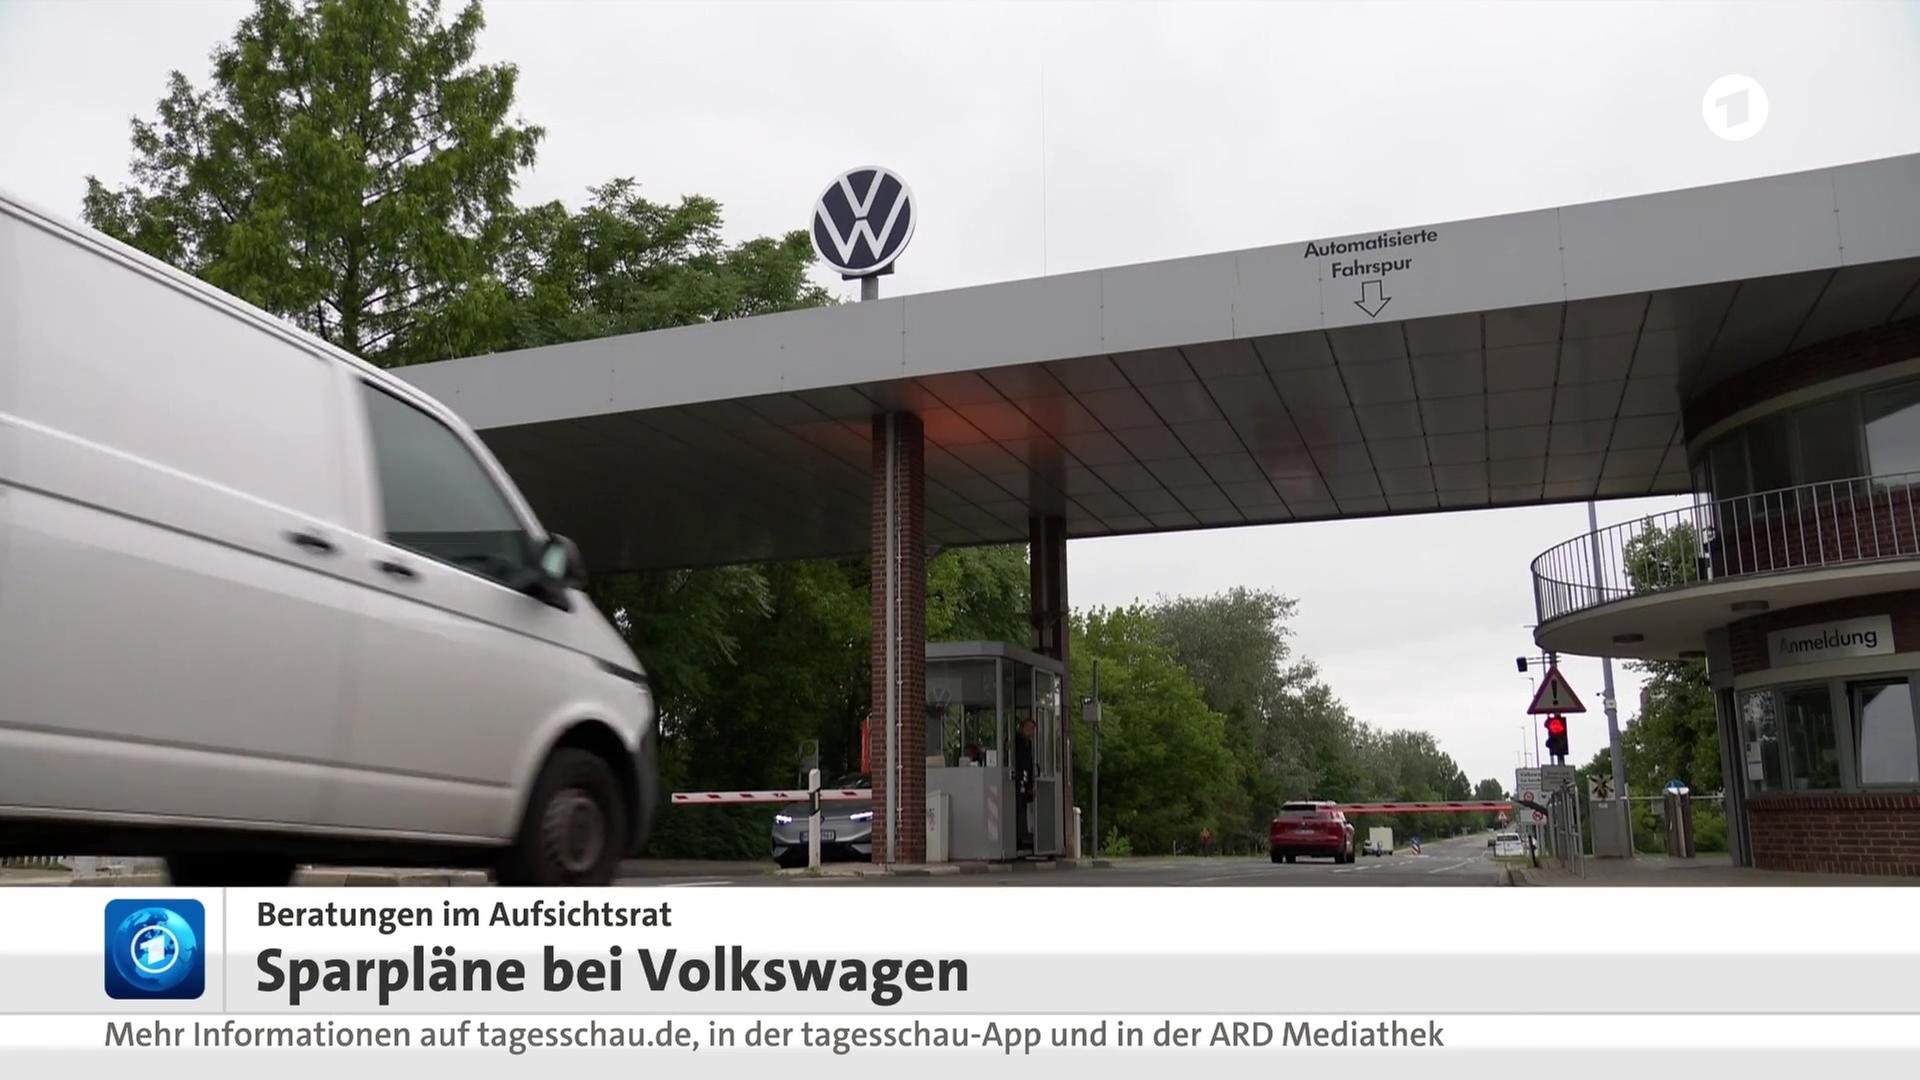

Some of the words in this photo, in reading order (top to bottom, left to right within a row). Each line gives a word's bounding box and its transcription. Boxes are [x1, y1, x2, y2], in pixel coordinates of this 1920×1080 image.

[814, 167, 911, 266] VW
[1304, 229, 1438, 258] Automatisierte
[1331, 258, 1413, 278] Fahrspur
[1780, 628, 1878, 653] Anmeldung
